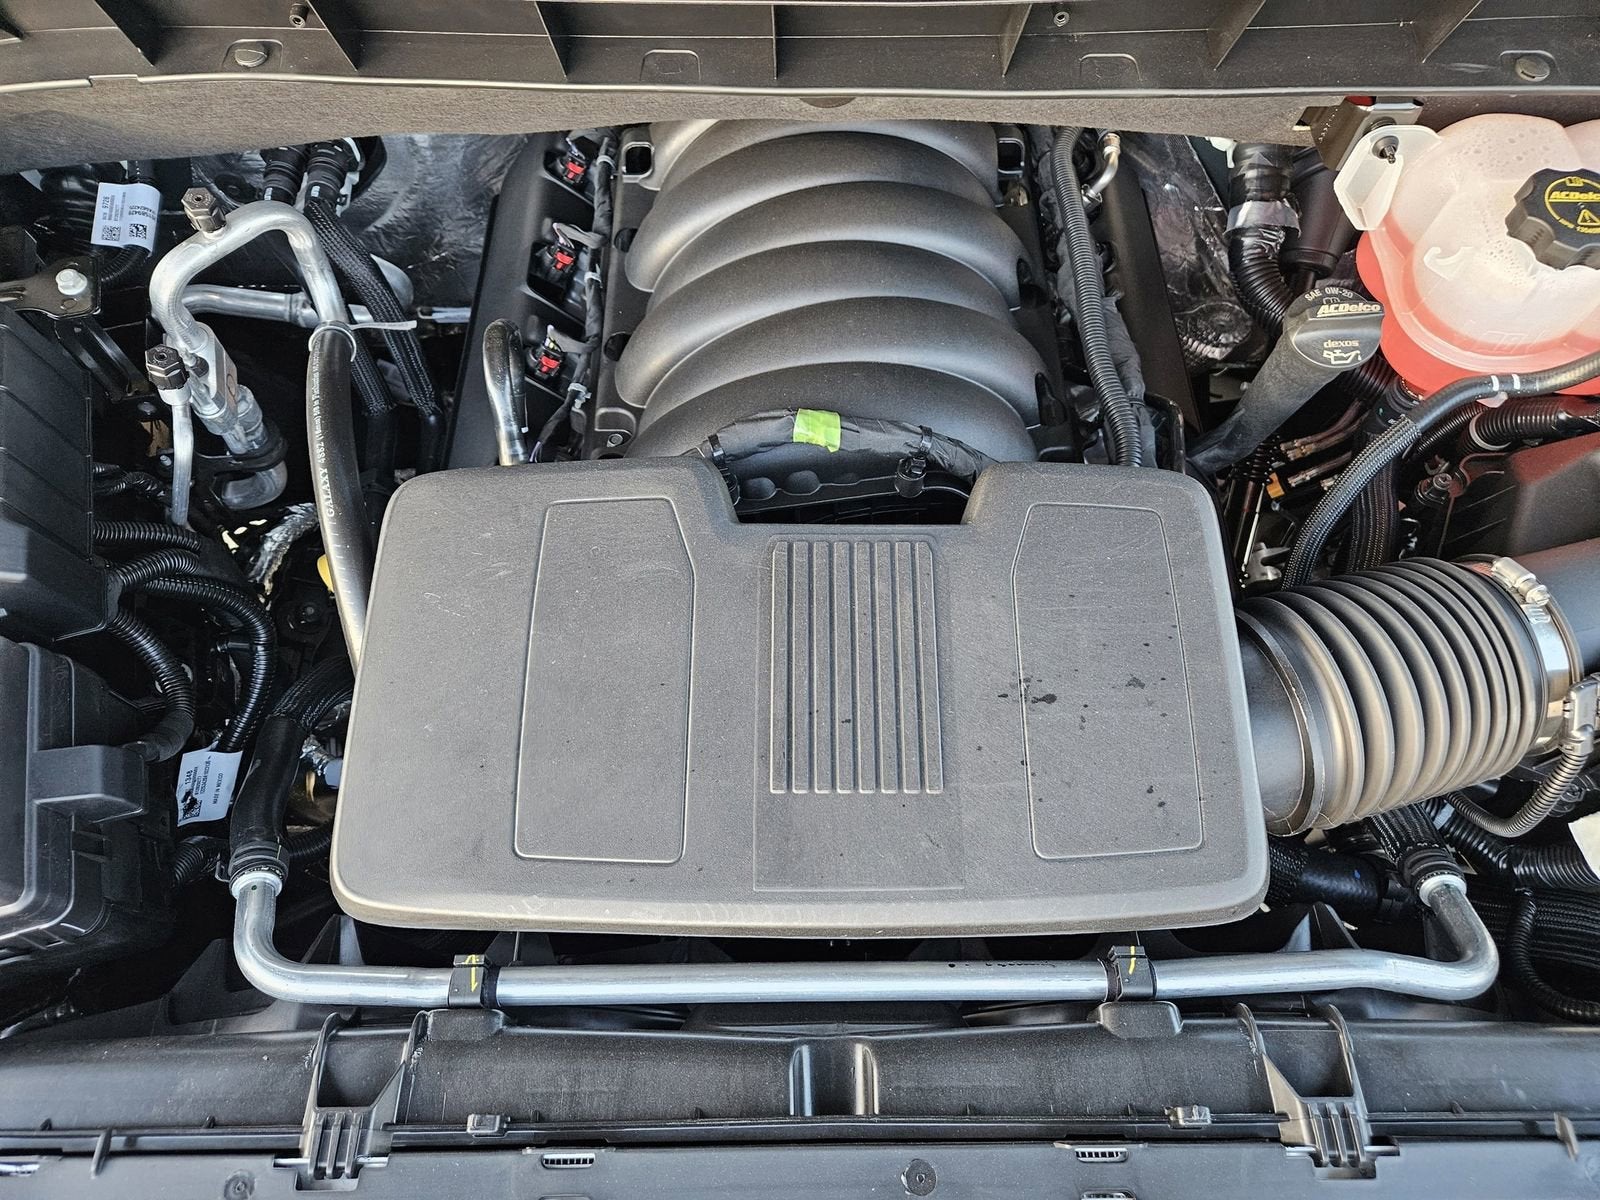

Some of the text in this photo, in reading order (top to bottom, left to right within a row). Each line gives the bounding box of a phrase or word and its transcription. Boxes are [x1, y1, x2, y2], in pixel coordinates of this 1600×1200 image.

[1549, 190, 1600, 200] ACDelc
[1304, 286, 1354, 301] SAE 0W-20
[1317, 302, 1381, 316] ACDelco
[1323, 339, 1360, 348] dexos
[316, 441, 326, 464] 4882
[319, 466, 336, 518] GALAXY
